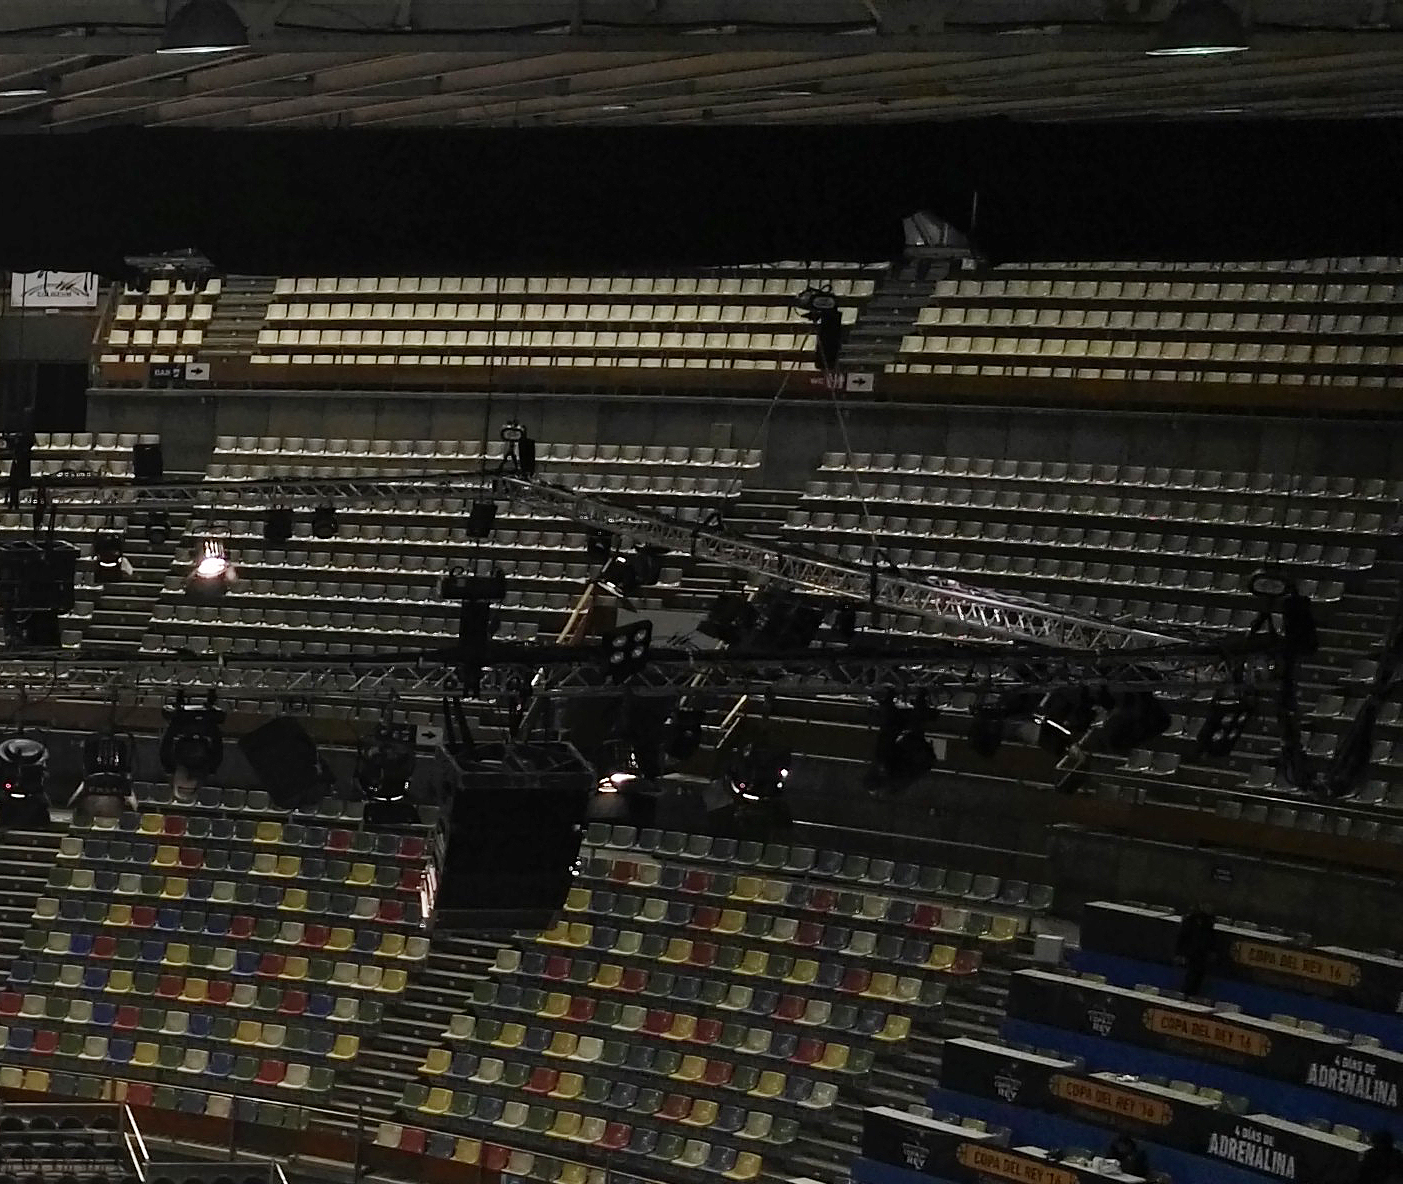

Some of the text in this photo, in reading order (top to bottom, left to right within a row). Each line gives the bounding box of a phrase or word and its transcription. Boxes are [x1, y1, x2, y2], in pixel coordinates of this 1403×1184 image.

[1306, 1062, 1398, 1107] ADRENALINA
[974, 1151, 1000, 1169] COPA
[1003, 1158, 1021, 1176] DEL
[1024, 1165, 1044, 1182] REY
[1207, 1132, 1296, 1179] ADRENALINA
